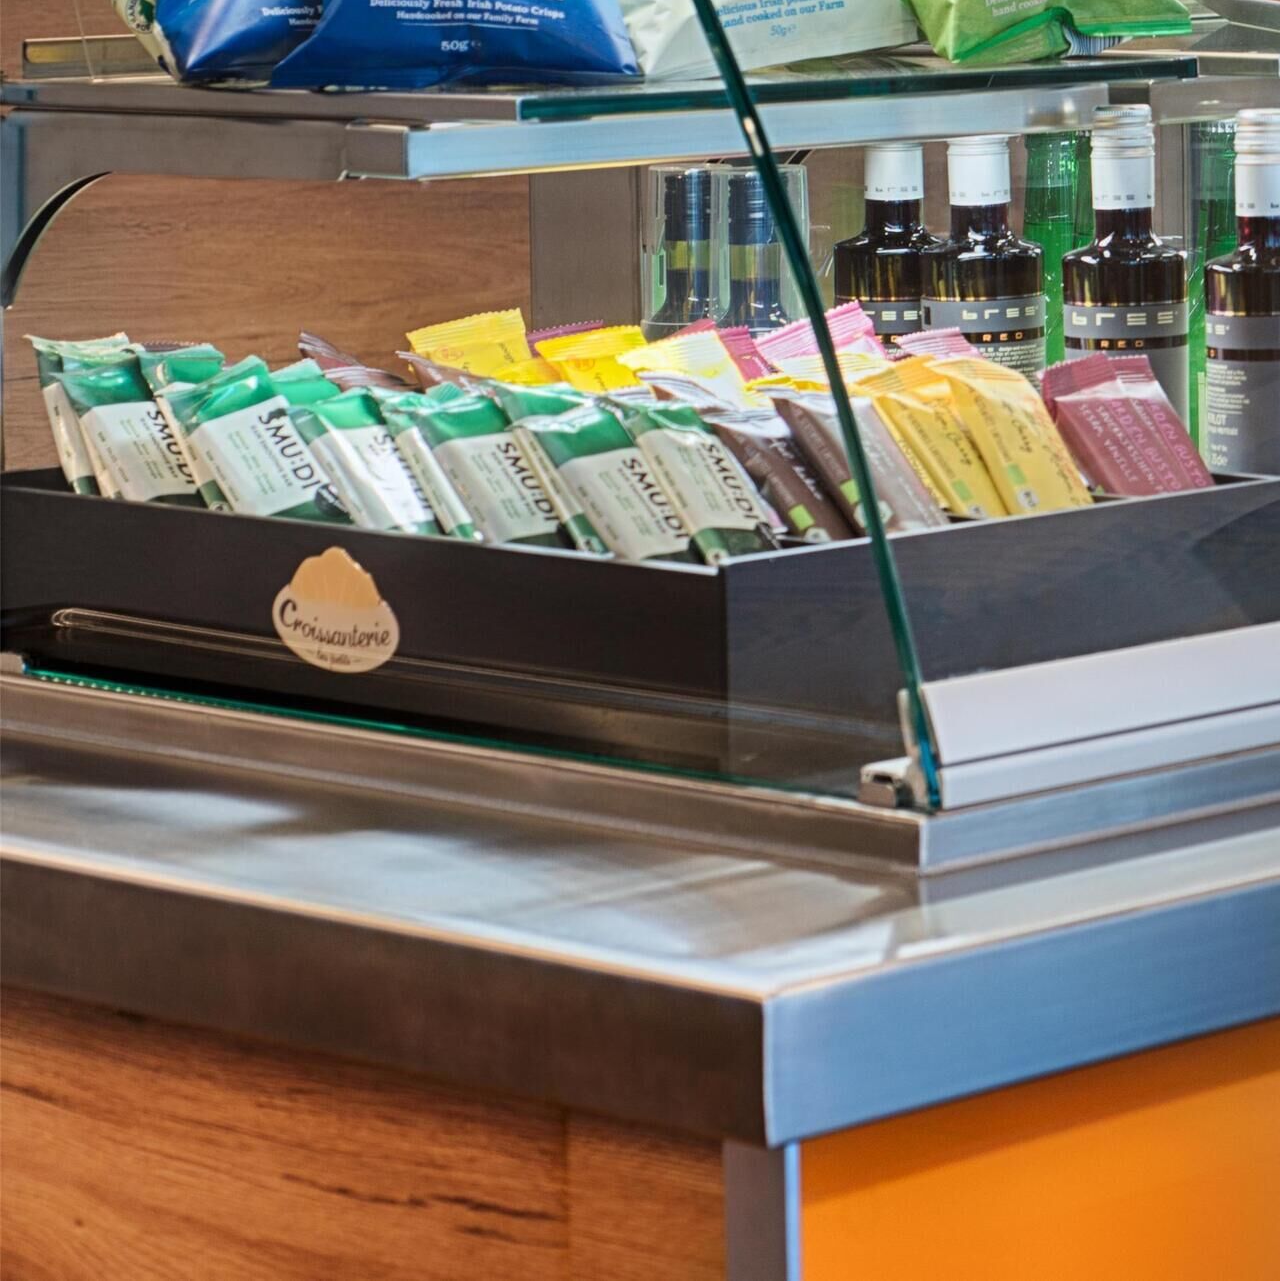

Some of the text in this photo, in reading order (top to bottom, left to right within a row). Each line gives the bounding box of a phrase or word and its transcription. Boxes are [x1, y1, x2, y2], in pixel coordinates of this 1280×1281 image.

[396, 11, 539, 25] Handcooked on our Family Farm
[495, 0, 529, 15] Potato
[531, 5, 565, 20] Crisps
[721, 0, 845, 28] and cooked on our Farm
[991, 3, 1016, 17] hand
[441, 40, 470, 52] 50g
[982, 332, 1023, 342] RED
[1100, 340, 1144, 349] RED
[258, 408, 321, 489] SMU:DI
[701, 443, 760, 520] SMU:DI
[622, 458, 689, 539] SMU:DI
[279, 599, 391, 647] Croissanterie
